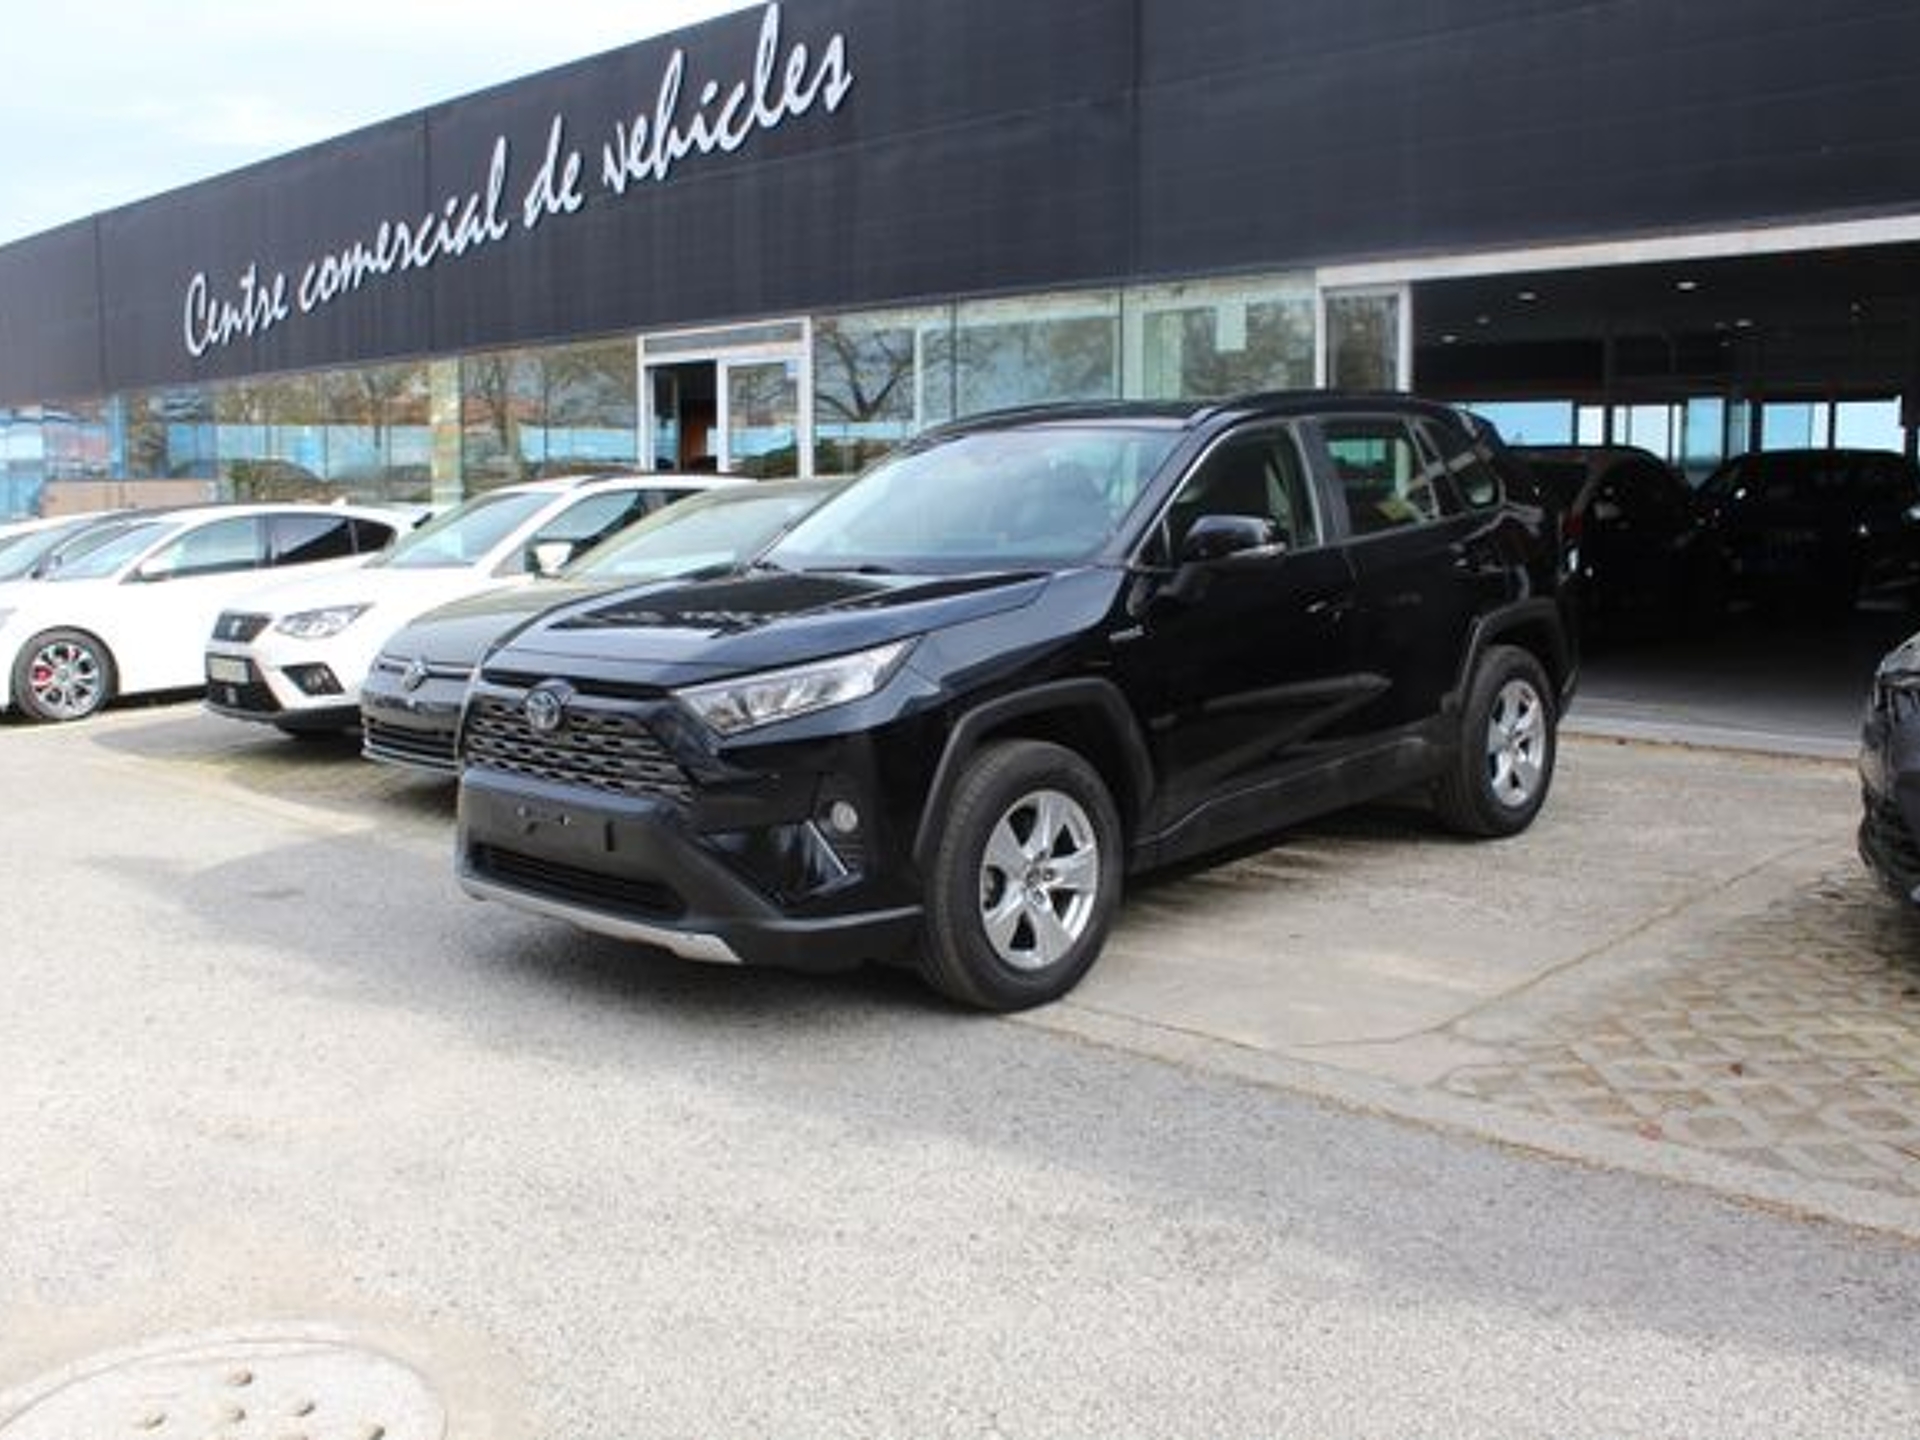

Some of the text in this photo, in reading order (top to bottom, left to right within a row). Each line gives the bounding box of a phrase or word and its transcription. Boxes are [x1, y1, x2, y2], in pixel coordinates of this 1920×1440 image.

[184, 1, 853, 357] Centre comercial de vehicles
